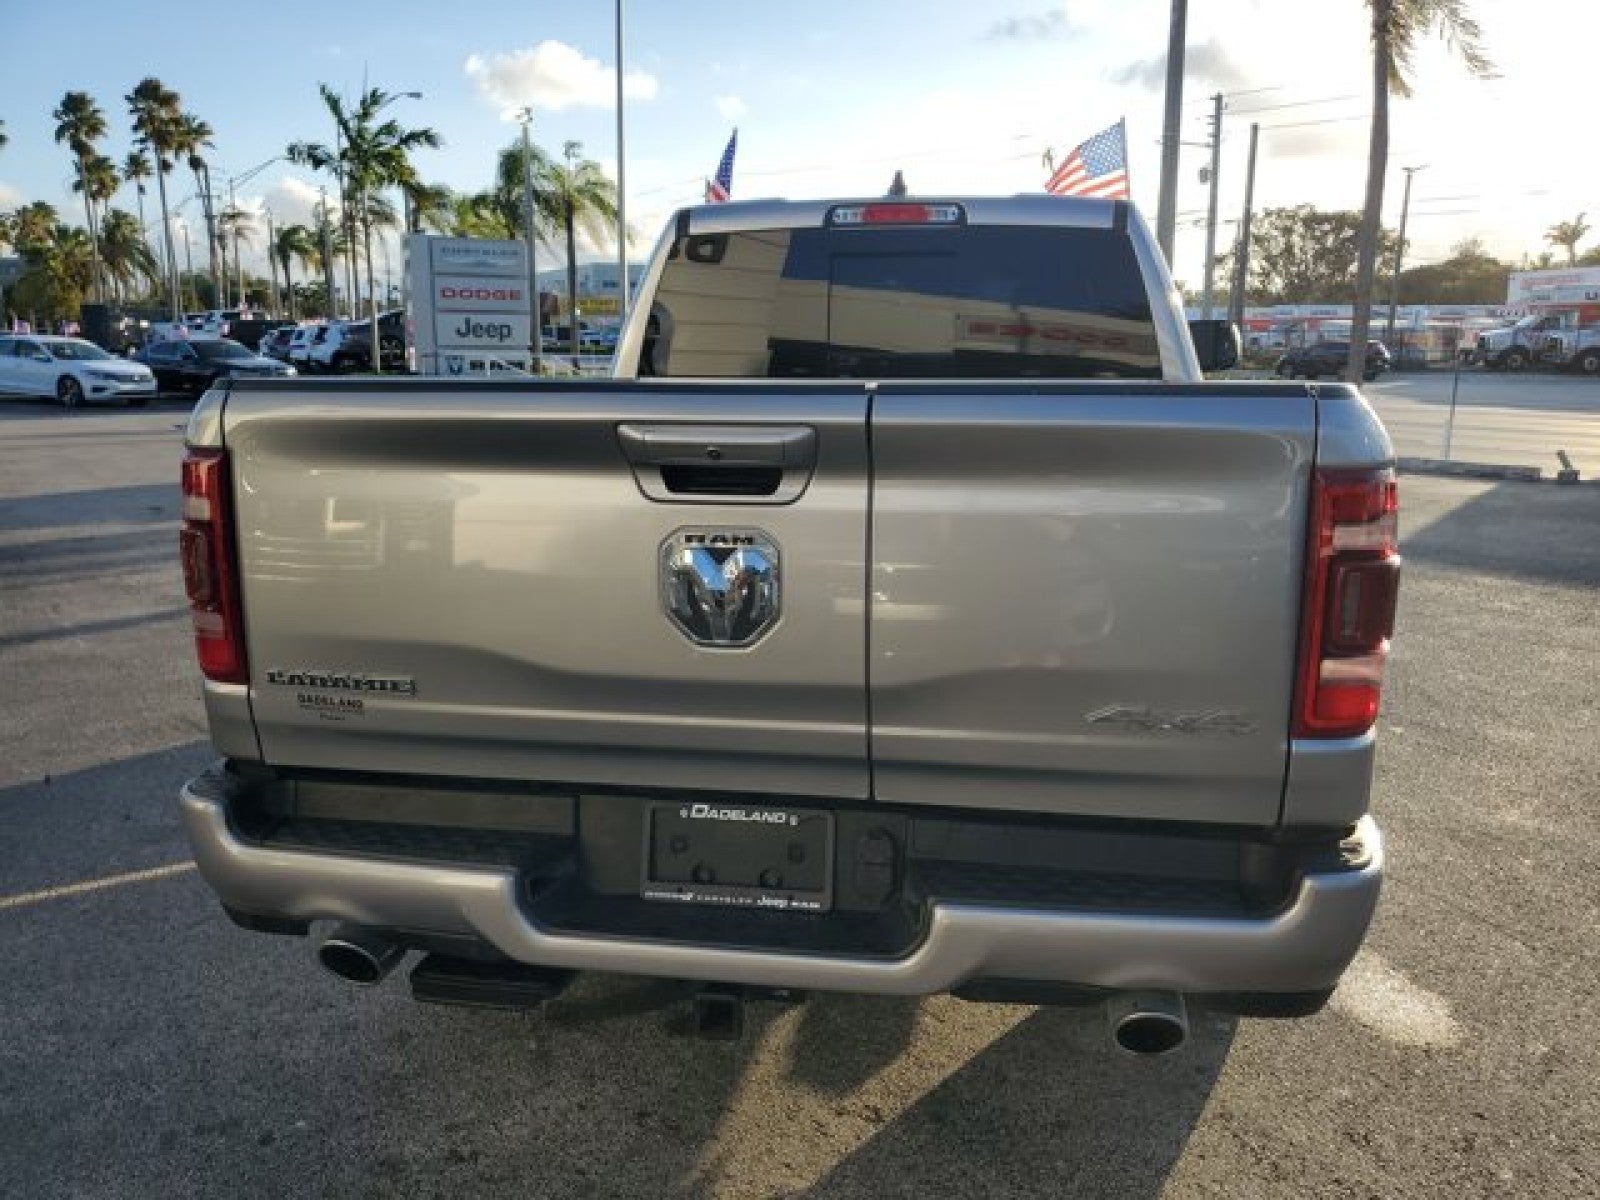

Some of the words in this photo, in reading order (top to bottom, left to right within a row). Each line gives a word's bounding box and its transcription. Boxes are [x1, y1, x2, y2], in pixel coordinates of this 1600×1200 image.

[440, 289, 521, 301] DODGE
[455, 317, 512, 341] Jeep
[469, 359, 526, 371] RAM
[684, 534, 754, 546] RAM
[266, 671, 417, 696] LARAMIE
[297, 694, 364, 709] DADELAND
[757, 895, 788, 908] Jeep
